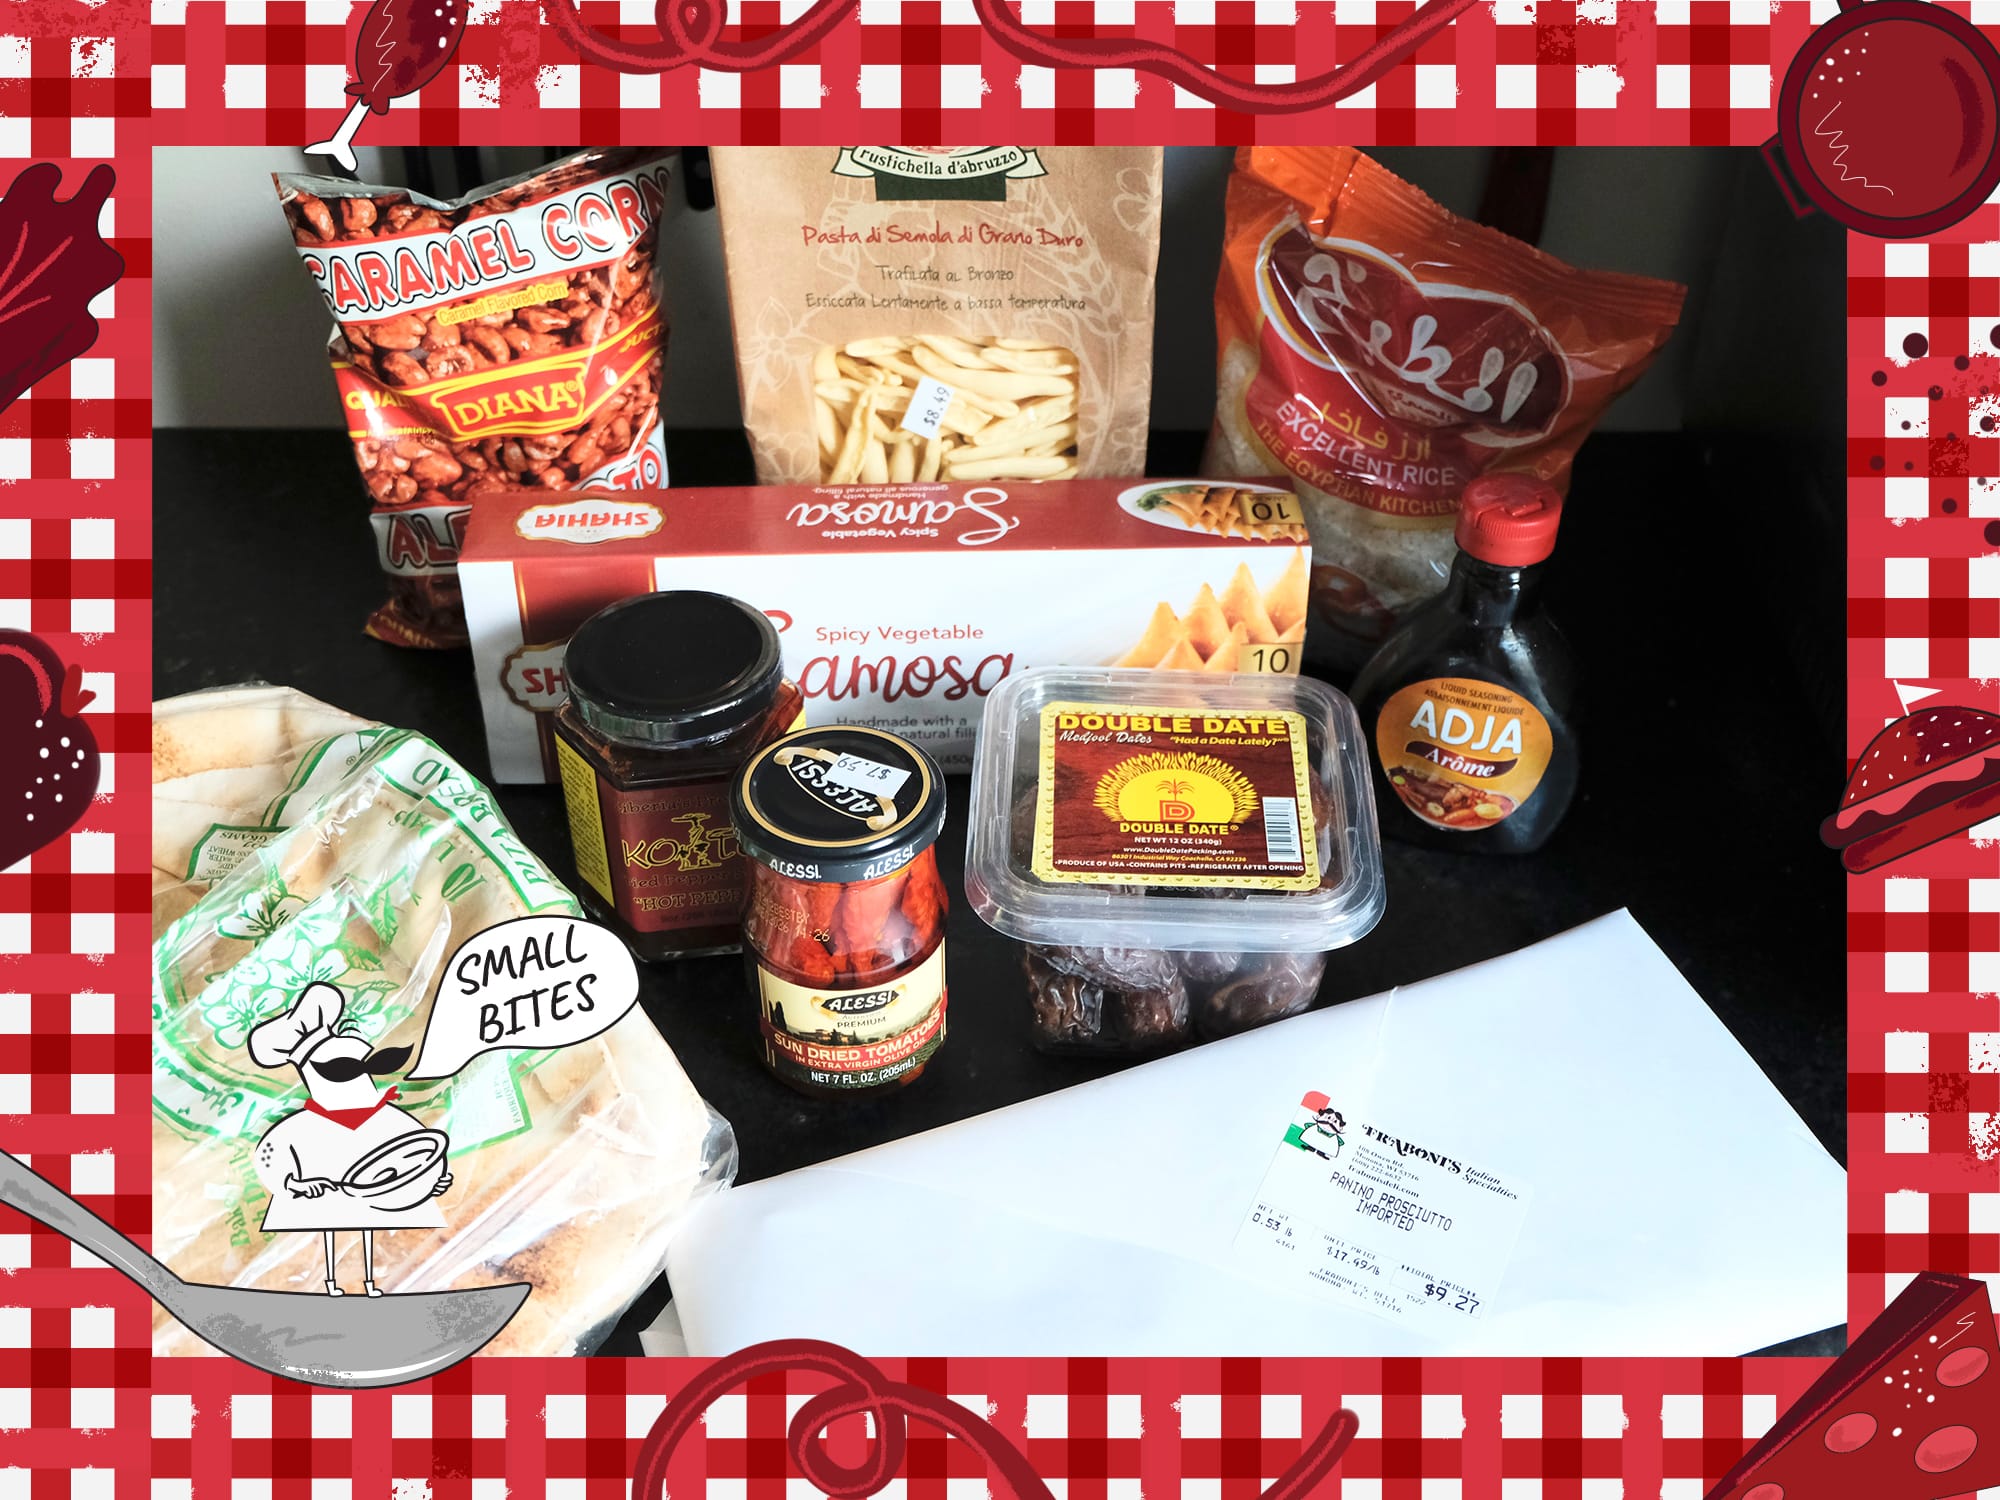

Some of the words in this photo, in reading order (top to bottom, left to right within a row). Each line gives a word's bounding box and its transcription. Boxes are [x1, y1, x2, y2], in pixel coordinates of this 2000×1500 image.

[859, 146, 944, 176] rustichella
[947, 151, 1018, 175] d'abruzzo
[801, 224, 861, 247] Pasta
[865, 226, 882, 244] di
[885, 220, 953, 245] Semola
[961, 226, 974, 243] di
[979, 223, 1033, 245] Grano
[1036, 227, 1084, 248] Duro
[968, 266, 1014, 282] Bronzo
[440, 302, 486, 325] Caramel
[487, 287, 536, 317] Flavored
[538, 281, 568, 303] Corn
[805, 292, 866, 309] Essiccata
[953, 299, 962, 311] a
[967, 292, 1003, 310] bassa
[1276, 401, 1396, 477] EXCELLENT
[1403, 466, 1456, 486] RICE
[1256, 422, 1283, 455] THE
[1285, 452, 1376, 505] EGYPTIAN
[534, 511, 650, 528] SHAHIA
[785, 486, 1020, 546] Samosa
[1251, 502, 1291, 521] 10
[821, 527, 897, 540] Vegetable
[899, 527, 939, 539] Spicy
[816, 626, 870, 645] Spicy
[877, 624, 984, 645] Vegetable
[1253, 648, 1290, 674] 10
[1425, 689, 1492, 714] ASSAISONNEMENT
[1493, 703, 1526, 716] LIQUIDE
[1441, 681, 1468, 695] LIQUID
[1469, 688, 1514, 703] SEASONING
[836, 716, 918, 727] Handmade
[922, 715, 954, 726] with
[959, 718, 968, 726] a
[1058, 715, 1193, 734] DOUBLE
[1203, 718, 1288, 736] DATE
[1410, 700, 1522, 755] ADJA
[1059, 730, 1112, 746] Medjool
[1116, 731, 1153, 745] Dates
[1209, 736, 1238, 746] Date
[837, 757, 892, 780] $7.59
[1425, 748, 1495, 778] Arôme
[1120, 822, 1185, 835] DOUBLE
[1123, 846, 1235, 856] www.DoubleDatePacking.com
[1134, 836, 1150, 844] NET
[1152, 836, 1168, 845] WT
[1169, 837, 1179, 845] 12
[1180, 837, 1193, 846] OZ
[1195, 837, 1223, 847] (340g)
[491, 828, 551, 885] PITA
[863, 844, 915, 880] ALESSI
[1097, 860, 1107, 868] OF
[1170, 862, 1187, 870] PITS
[1242, 864, 1267, 872] AFTER
[1166, 855, 1180, 863] Way
[769, 858, 822, 879] ALESSI
[828, 989, 893, 1011] ALESSI
[836, 1015, 886, 1028] PREMIUM
[774, 1032, 803, 1054] SUN
[807, 1047, 861, 1062] DRIED
[865, 1007, 941, 1060] TOMATOES
[795, 1054, 806, 1063] IN
[808, 1059, 842, 1069] EXTRA
[844, 1058, 881, 1069] VIRGIN
[884, 1047, 912, 1063] OLIVE
[913, 1037, 926, 1049] OIL
[811, 1071, 831, 1084] NET
[833, 1074, 840, 1084] 7
[842, 1073, 858, 1085] FL.
[860, 1071, 877, 1083] OZ.
[879, 1056, 917, 1082] (205mL)
[1461, 1173, 1519, 1200] Specialties
[1465, 1166, 1501, 1185] Italian
[1330, 1171, 1375, 1200] PANINO
[1378, 1192, 1453, 1232] PROSCIUTTO
[1251, 1212, 1281, 1232] 0.53
[1355, 1198, 1415, 1233] IMPORTED
[1350, 1244, 1377, 1261] PRICE
[1423, 1282, 1480, 1315] $9.27
